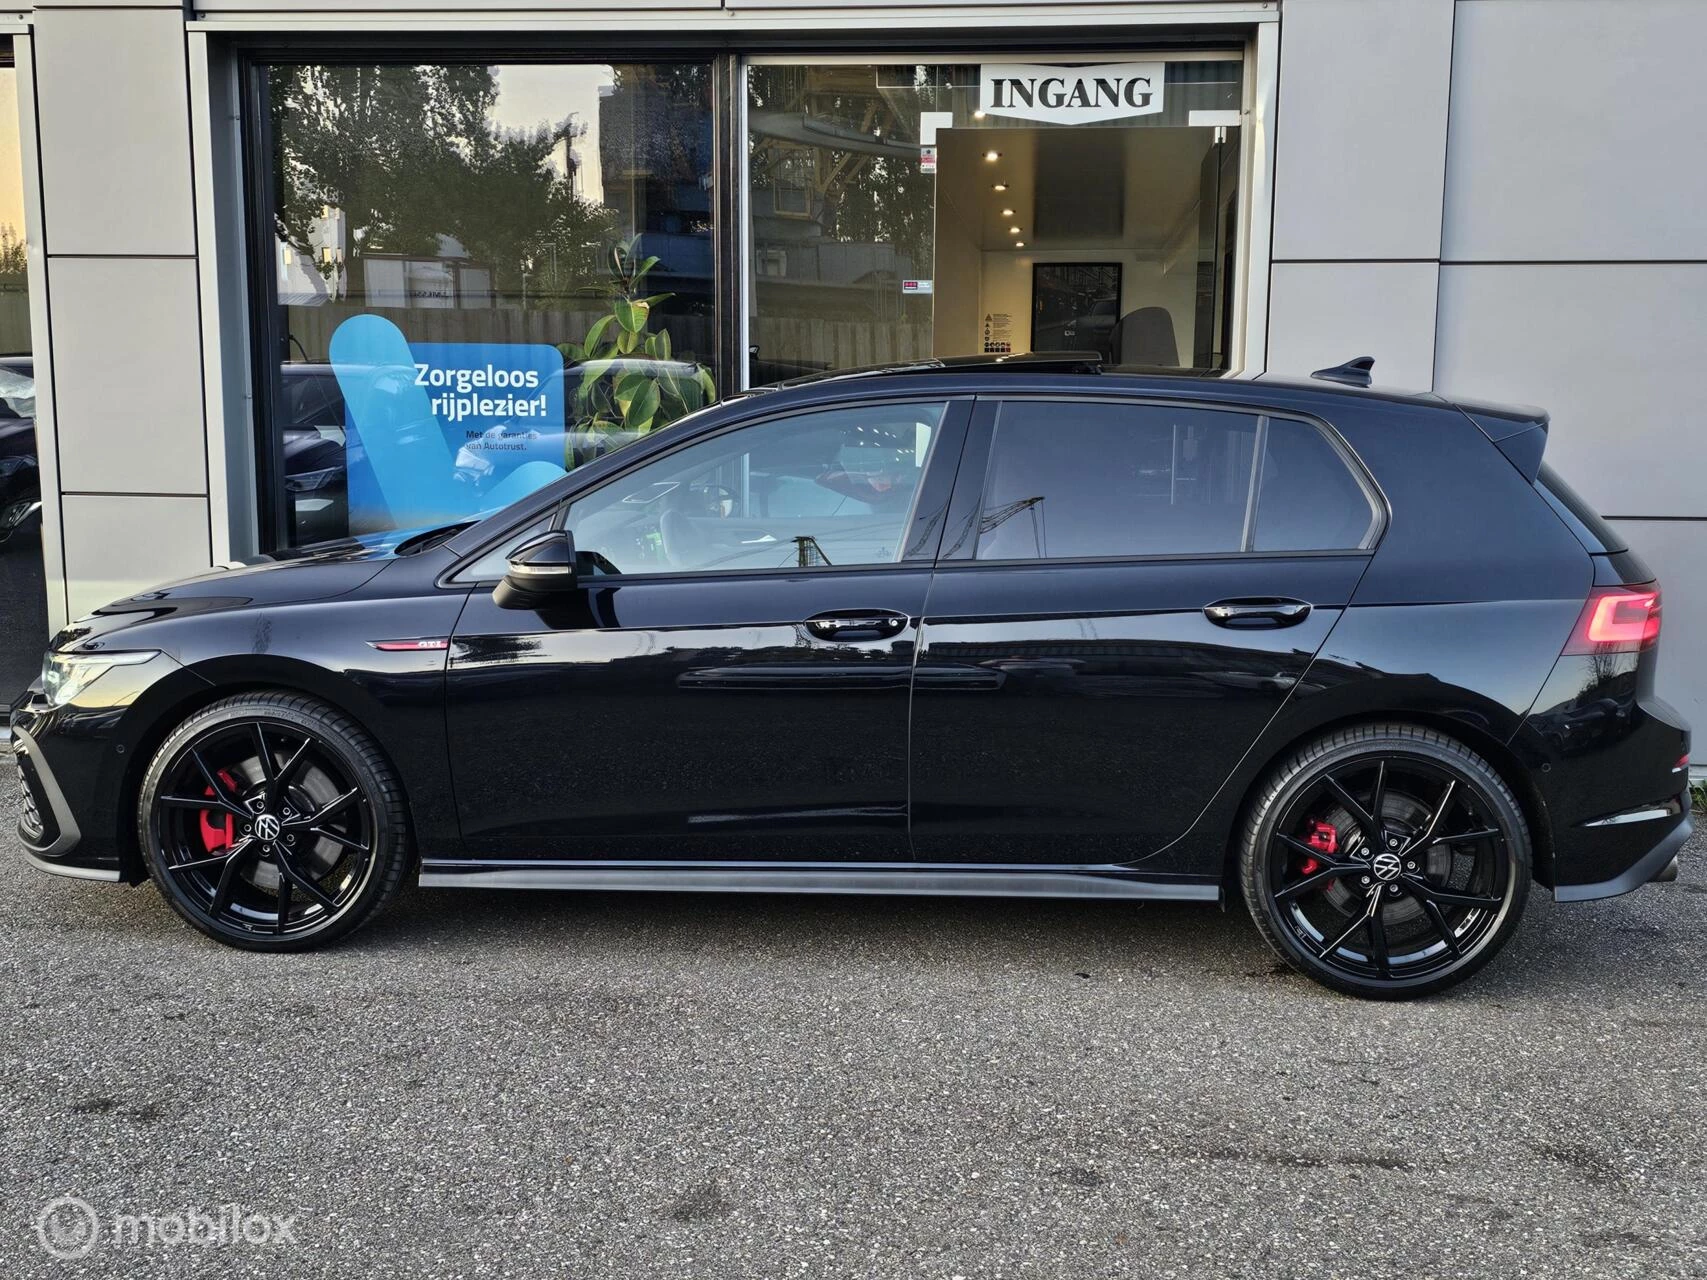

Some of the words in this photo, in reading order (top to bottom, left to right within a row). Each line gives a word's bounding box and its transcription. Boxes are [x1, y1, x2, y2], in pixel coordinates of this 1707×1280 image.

[991, 78, 1153, 108] INGANG
[414, 364, 539, 393] Zorgeloos
[431, 393, 546, 422] rijplezier!
[466, 430, 483, 439] Met
[485, 430, 496, 439] de
[497, 430, 537, 441] garanties
[483, 442, 527, 451] Autotrust.
[418, 640, 441, 648] GTI
